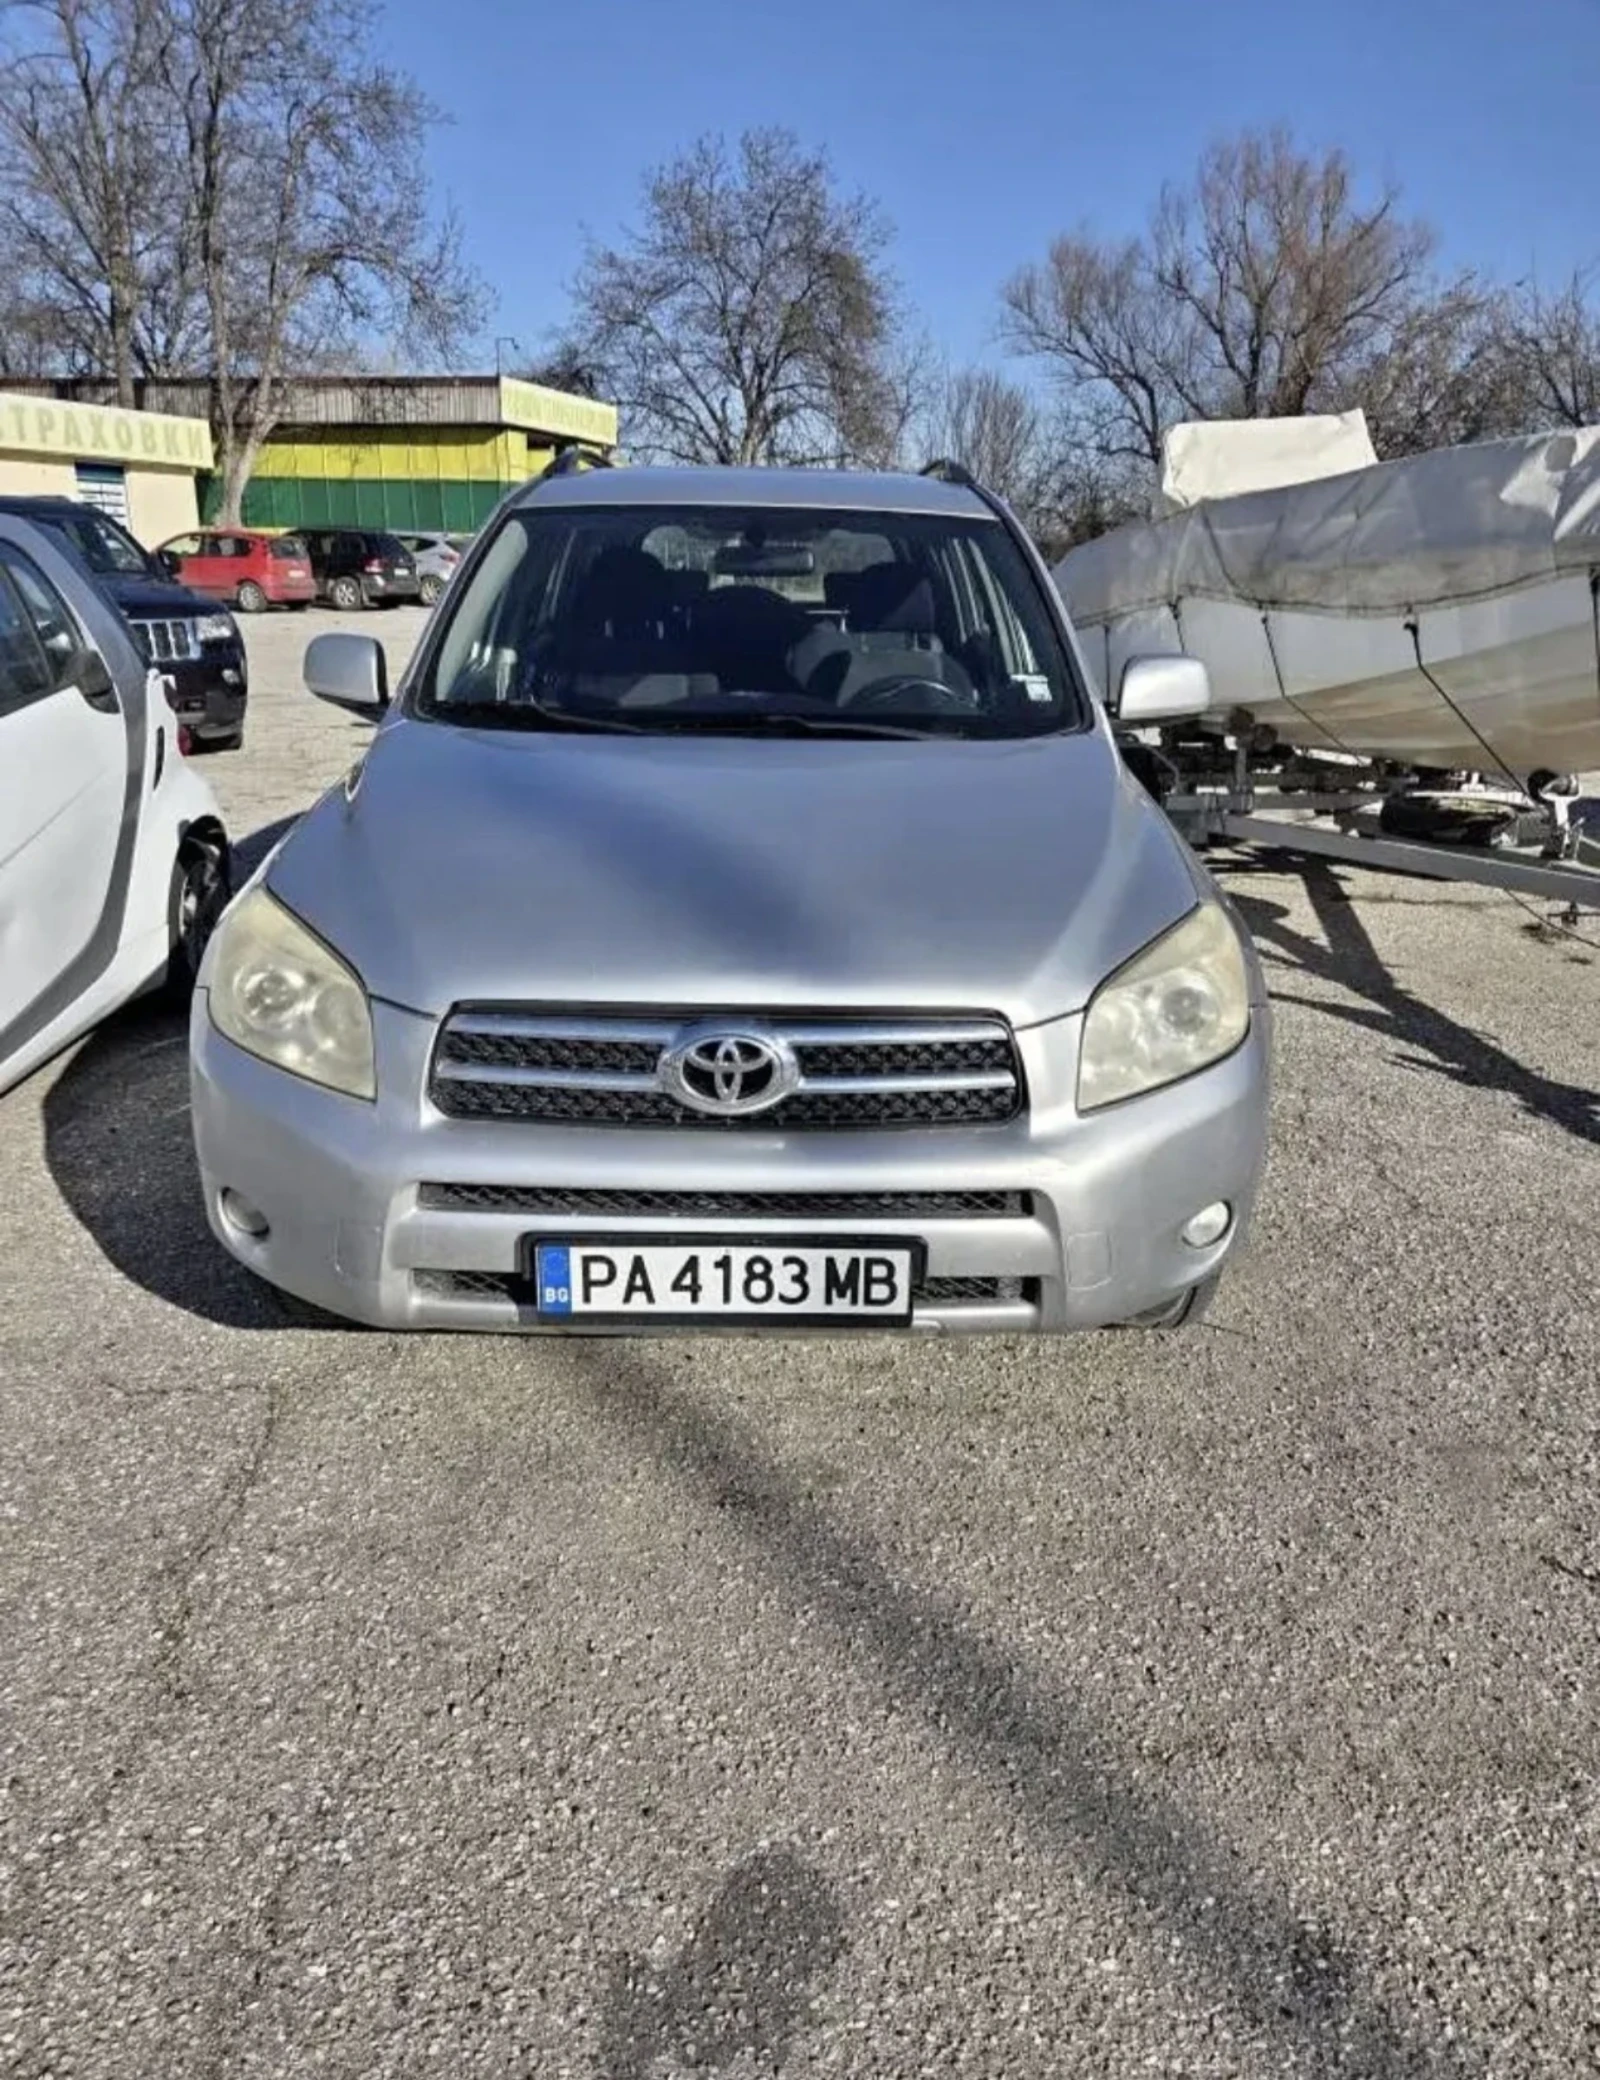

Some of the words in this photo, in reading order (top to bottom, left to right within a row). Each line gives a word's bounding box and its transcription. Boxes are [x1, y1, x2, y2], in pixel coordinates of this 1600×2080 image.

[0, 402, 205, 461] ТРАХОВКИ
[545, 1287, 569, 1303] BG
[581, 1254, 656, 1304] PA
[670, 1254, 811, 1306] 4183
[824, 1256, 898, 1307] MB
